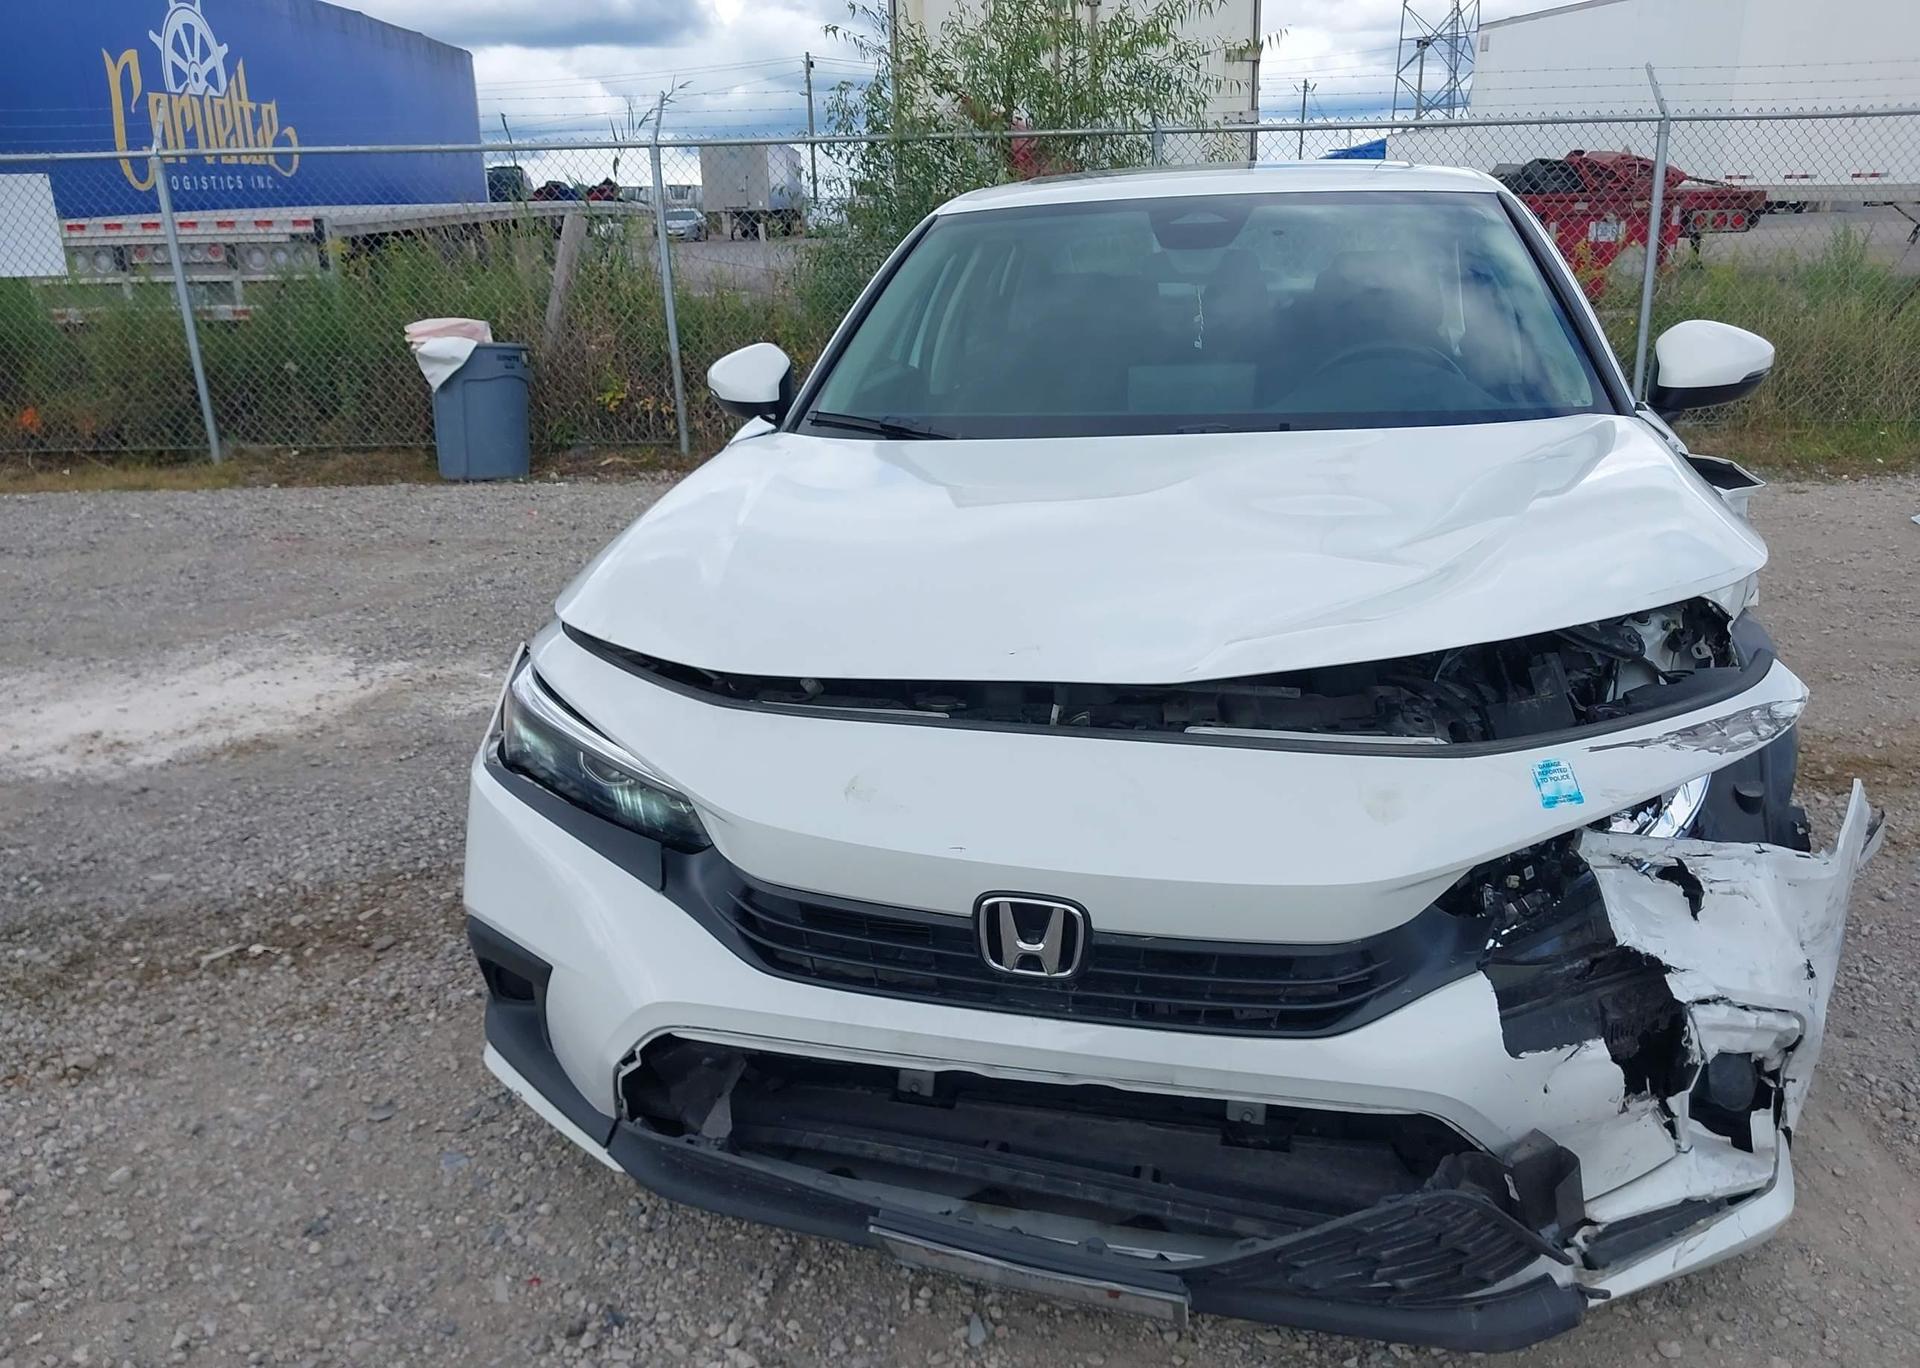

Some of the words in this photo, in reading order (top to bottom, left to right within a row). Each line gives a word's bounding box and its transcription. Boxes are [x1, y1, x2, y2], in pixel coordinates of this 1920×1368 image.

[169, 175, 244, 190] OGISTICS
[1538, 761, 1561, 769] DAMAGE
[1537, 768, 1568, 776] REPORTED
[1549, 774, 1571, 782] POLICE
